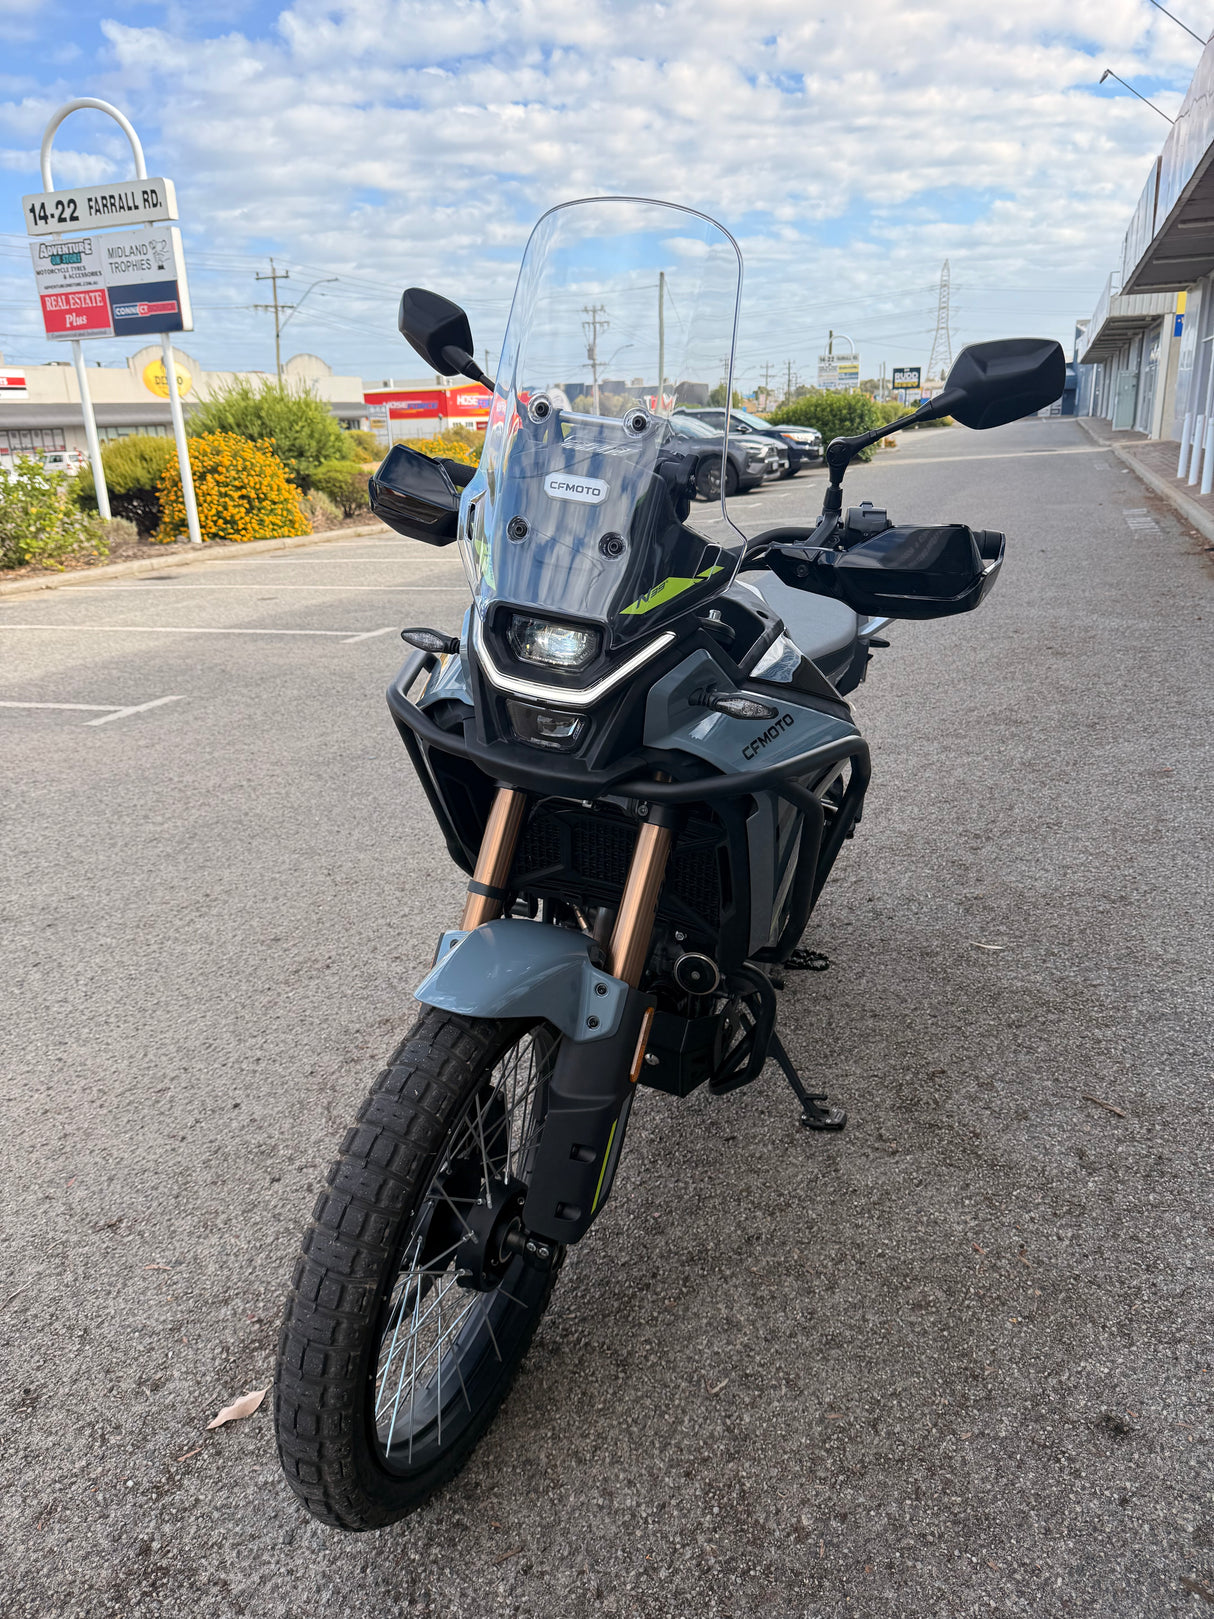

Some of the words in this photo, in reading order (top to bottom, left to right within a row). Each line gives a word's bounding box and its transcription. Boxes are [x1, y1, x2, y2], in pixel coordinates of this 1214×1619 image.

[29, 198, 80, 226] 14-22
[87, 191, 139, 216] FARRALL
[141, 189, 163, 209] RD.
[39, 238, 93, 259] ADVENTURE
[107, 243, 149, 259] MIDLAND
[109, 258, 152, 274] TROPHIES
[45, 295, 69, 310] REAL
[68, 292, 104, 308] ESTATE
[65, 312, 87, 328] Plus
[550, 481, 601, 496] CFMOTO
[741, 713, 795, 761] CFMOTO
